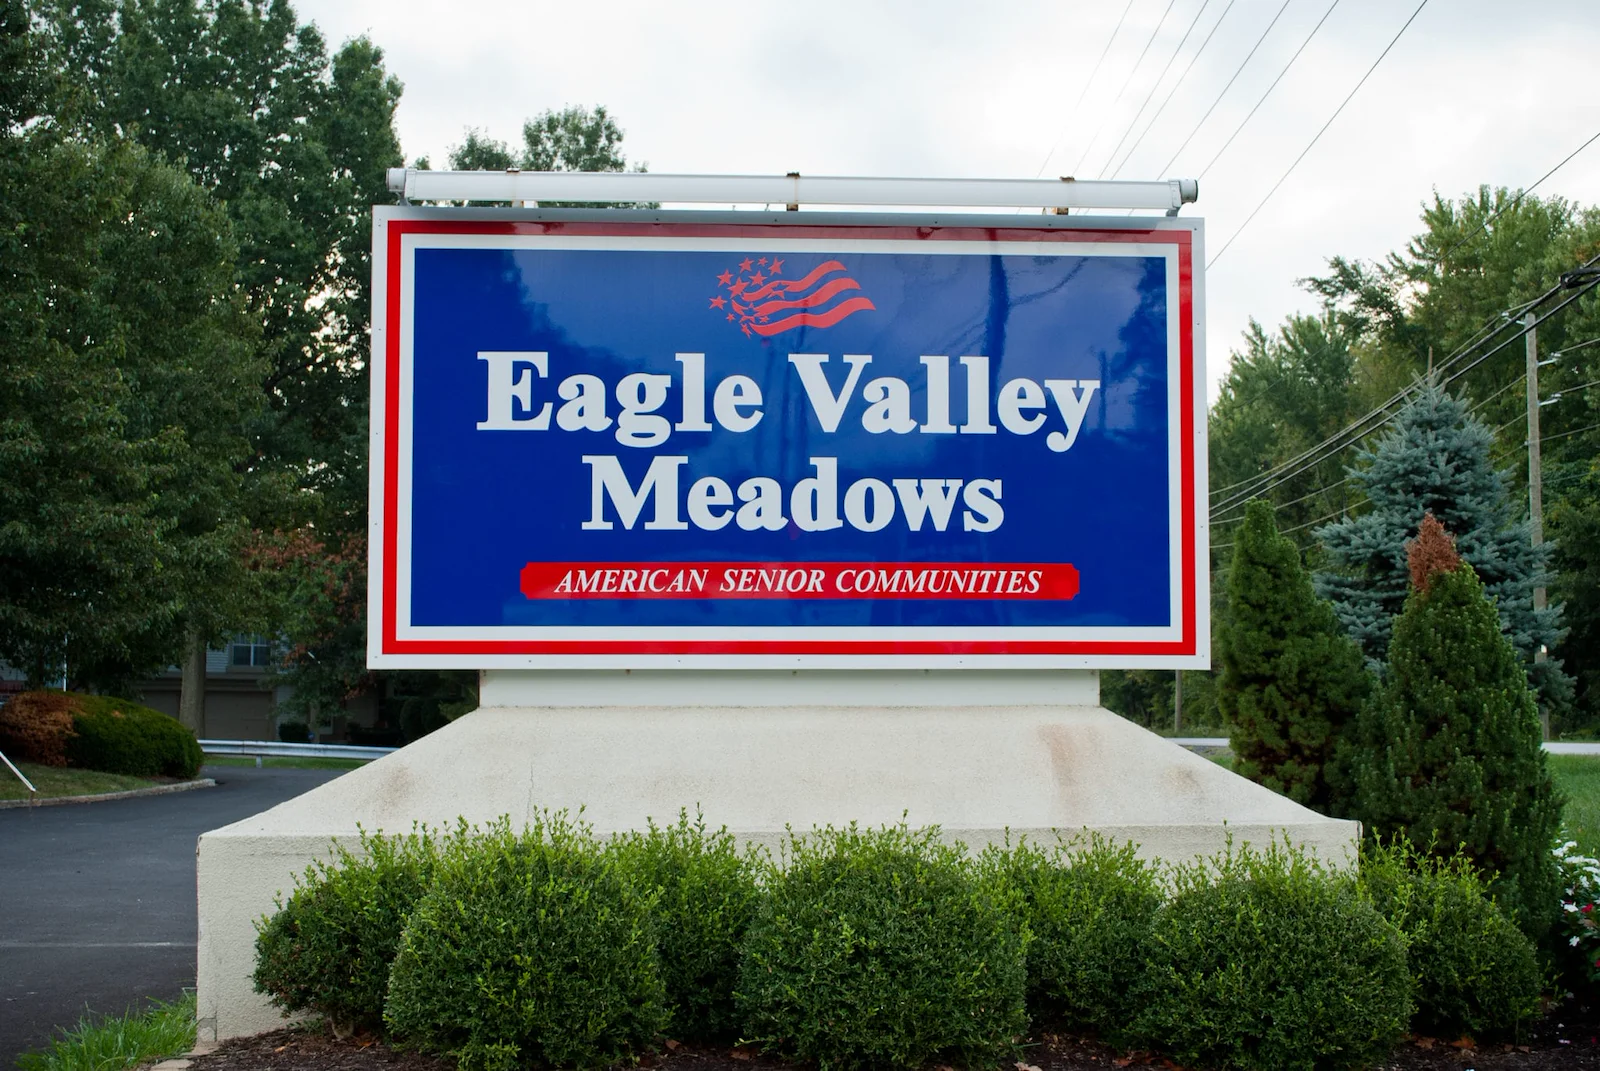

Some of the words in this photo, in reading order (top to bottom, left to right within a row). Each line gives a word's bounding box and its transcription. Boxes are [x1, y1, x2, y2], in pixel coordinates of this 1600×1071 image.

[477, 352, 764, 448] Eagle
[788, 354, 1101, 453] Valley
[581, 456, 1005, 533] Meadows
[553, 570, 709, 593] AMERICAN
[719, 569, 826, 592] SENIOR
[835, 570, 1042, 593] COMMUNITIES
